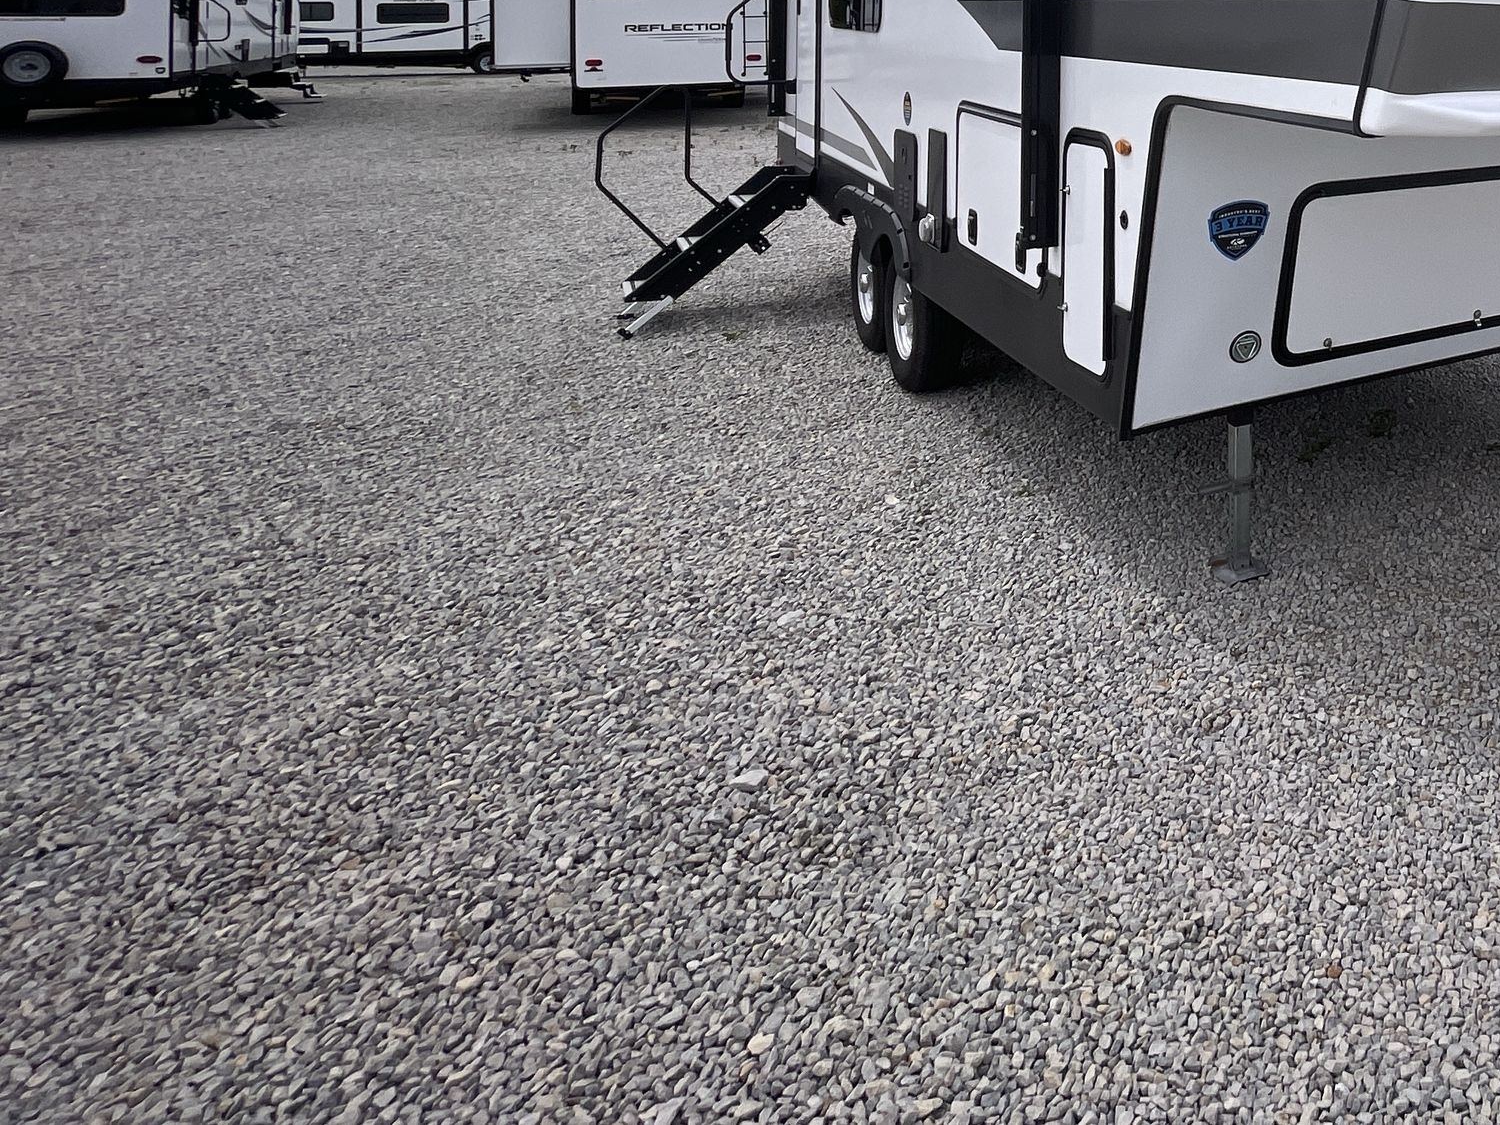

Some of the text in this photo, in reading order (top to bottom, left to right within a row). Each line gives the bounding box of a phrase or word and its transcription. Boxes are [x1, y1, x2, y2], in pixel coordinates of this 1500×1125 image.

[624, 23, 733, 32] REFLECTION
[1215, 215, 1262, 232] 3 YEAR
